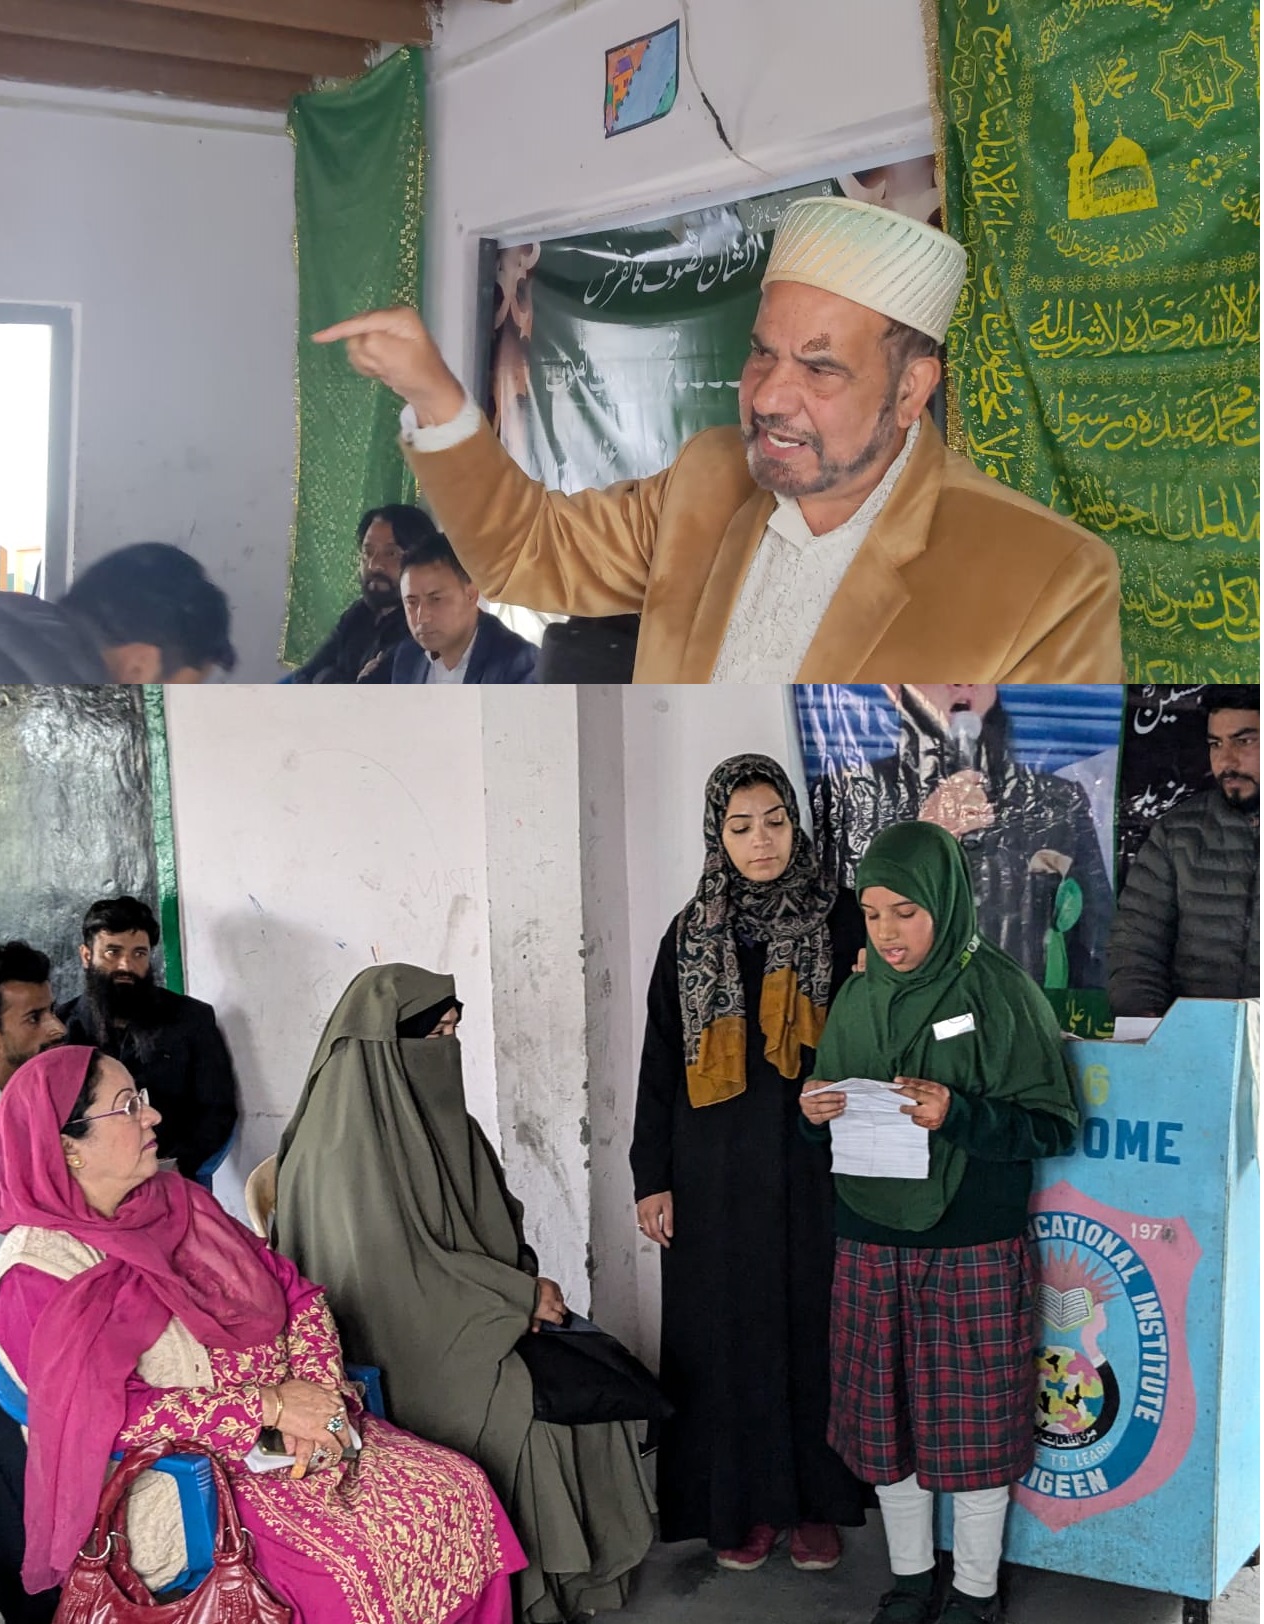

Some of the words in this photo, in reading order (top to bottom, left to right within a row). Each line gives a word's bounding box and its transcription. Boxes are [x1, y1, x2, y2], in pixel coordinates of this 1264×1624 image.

[583, 241, 651, 309] کانفرنس
[1131, 1291, 1168, 1425] INSTITUTE
[1050, 1453, 1068, 1467] TO
[1075, 1441, 1113, 1468] LEARN
[1017, 1466, 1109, 1498] IGEEN
